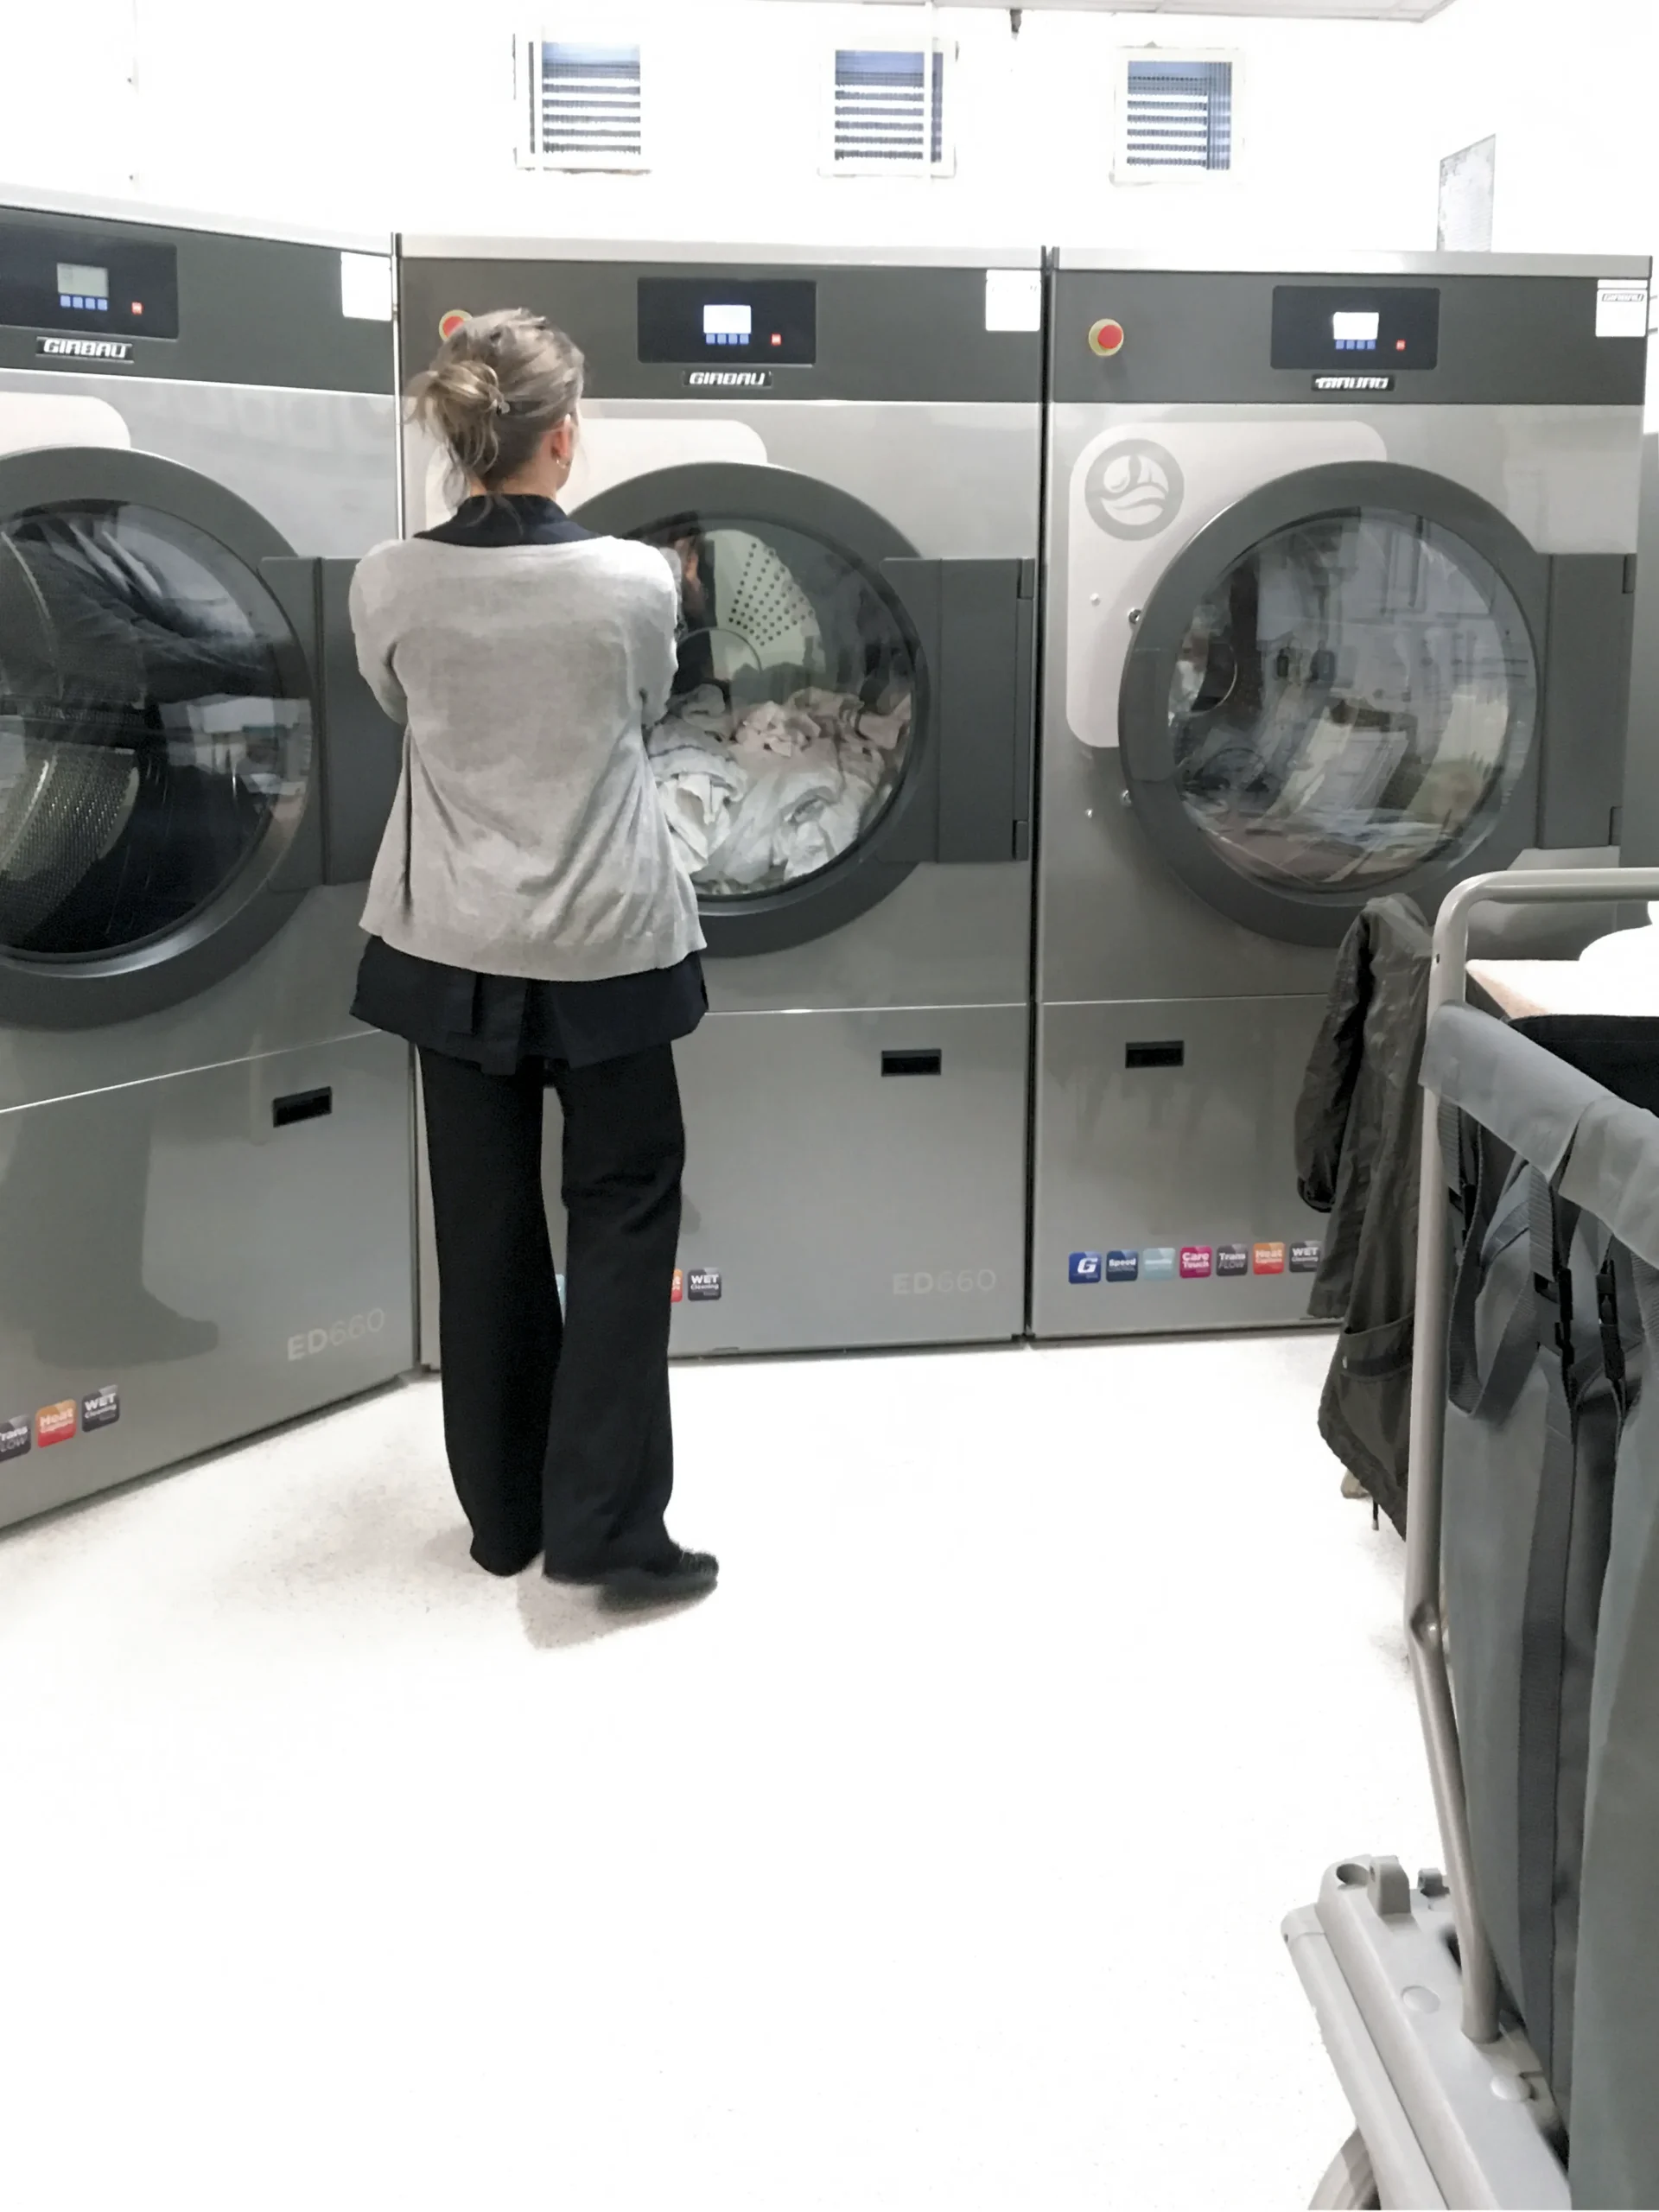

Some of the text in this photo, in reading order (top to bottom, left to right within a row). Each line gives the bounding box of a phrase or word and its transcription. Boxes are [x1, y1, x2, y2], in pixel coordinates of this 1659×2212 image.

[43, 338, 126, 359] GIRBAU
[689, 372, 766, 385] GIRBAU
[1182, 1252, 1210, 1261] Care
[1292, 1247, 1319, 1256] WET
[1077, 1258, 1098, 1274] G
[1109, 1258, 1136, 1267] Speed
[690, 1274, 719, 1284] WET
[893, 1269, 996, 1294] ED660
[287, 1307, 385, 1361] ED660
[84, 1392, 117, 1411] WET
[40, 1408, 73, 1427] Heat
[0, 1433, 28, 1452] LOW
